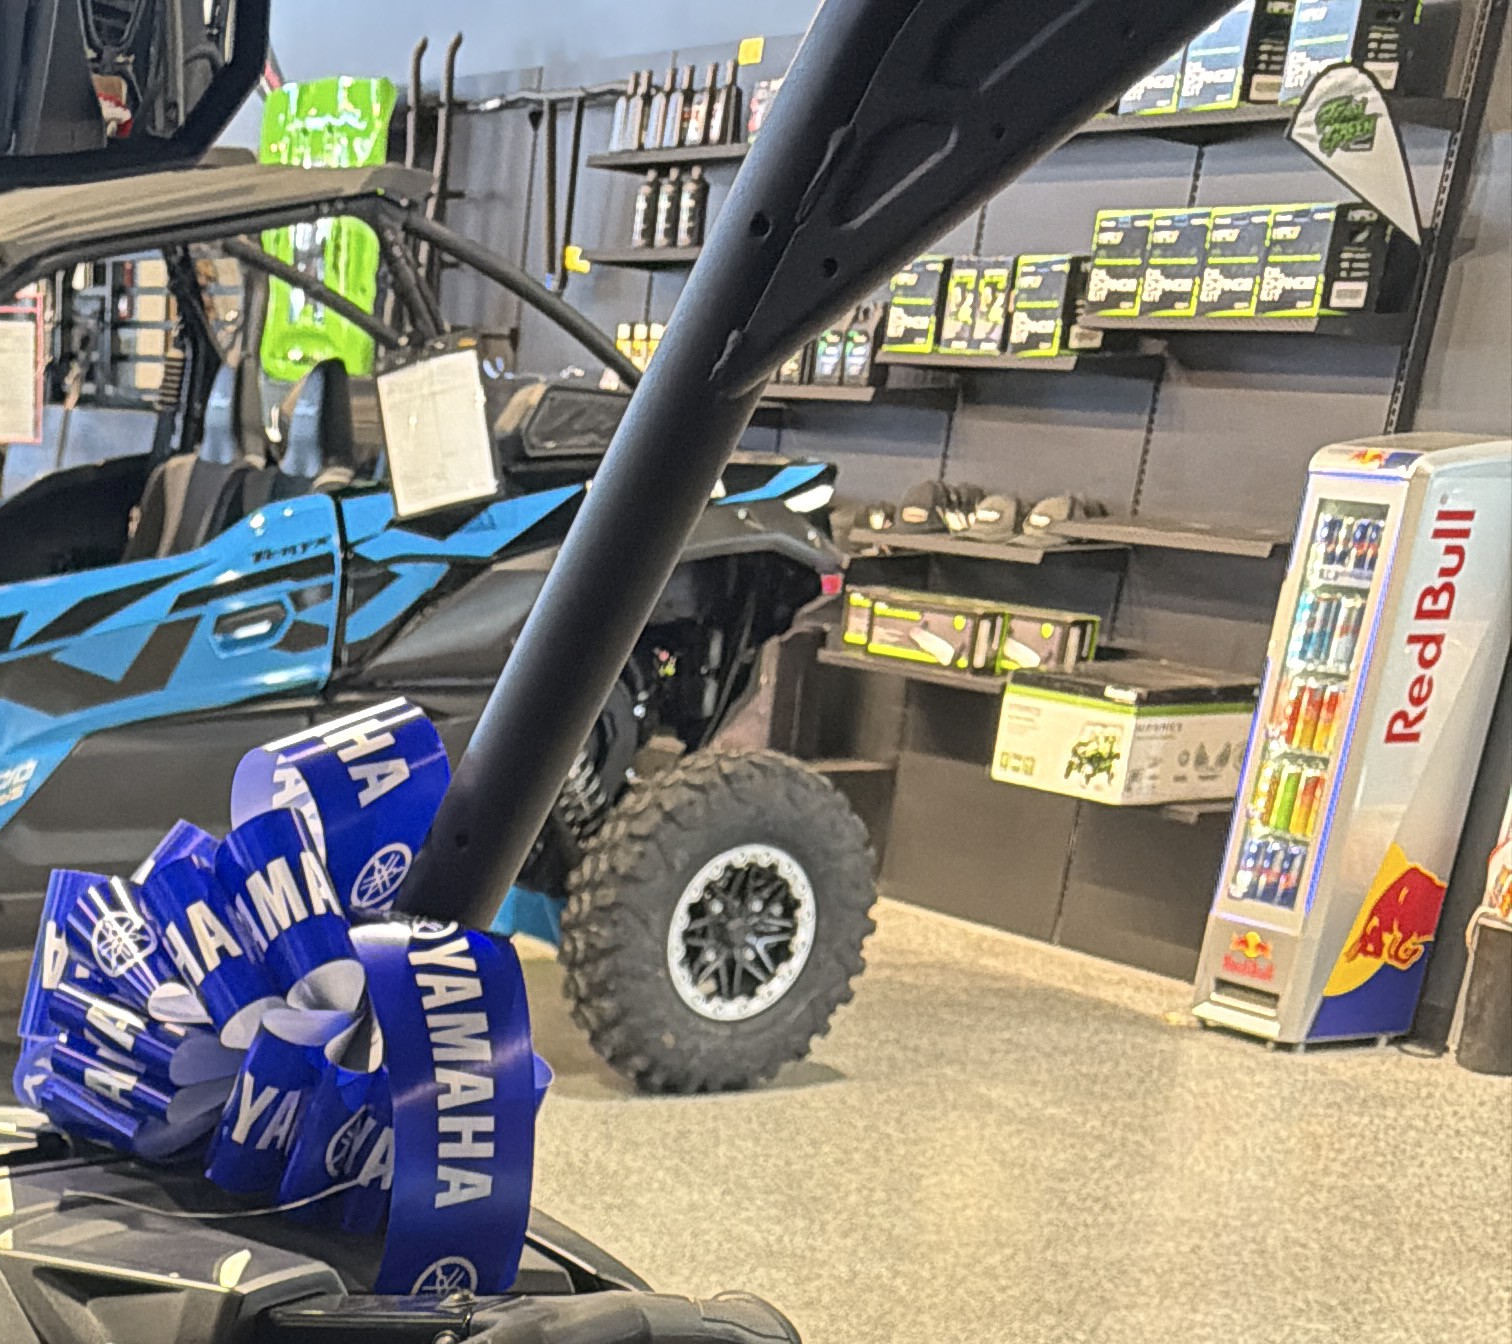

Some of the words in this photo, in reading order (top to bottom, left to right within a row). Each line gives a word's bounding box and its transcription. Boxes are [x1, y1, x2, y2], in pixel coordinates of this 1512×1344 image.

[1414, 508, 1477, 621] Bull
[1384, 632, 1445, 745] Red
[408, 933, 496, 1210] YAMAHA
